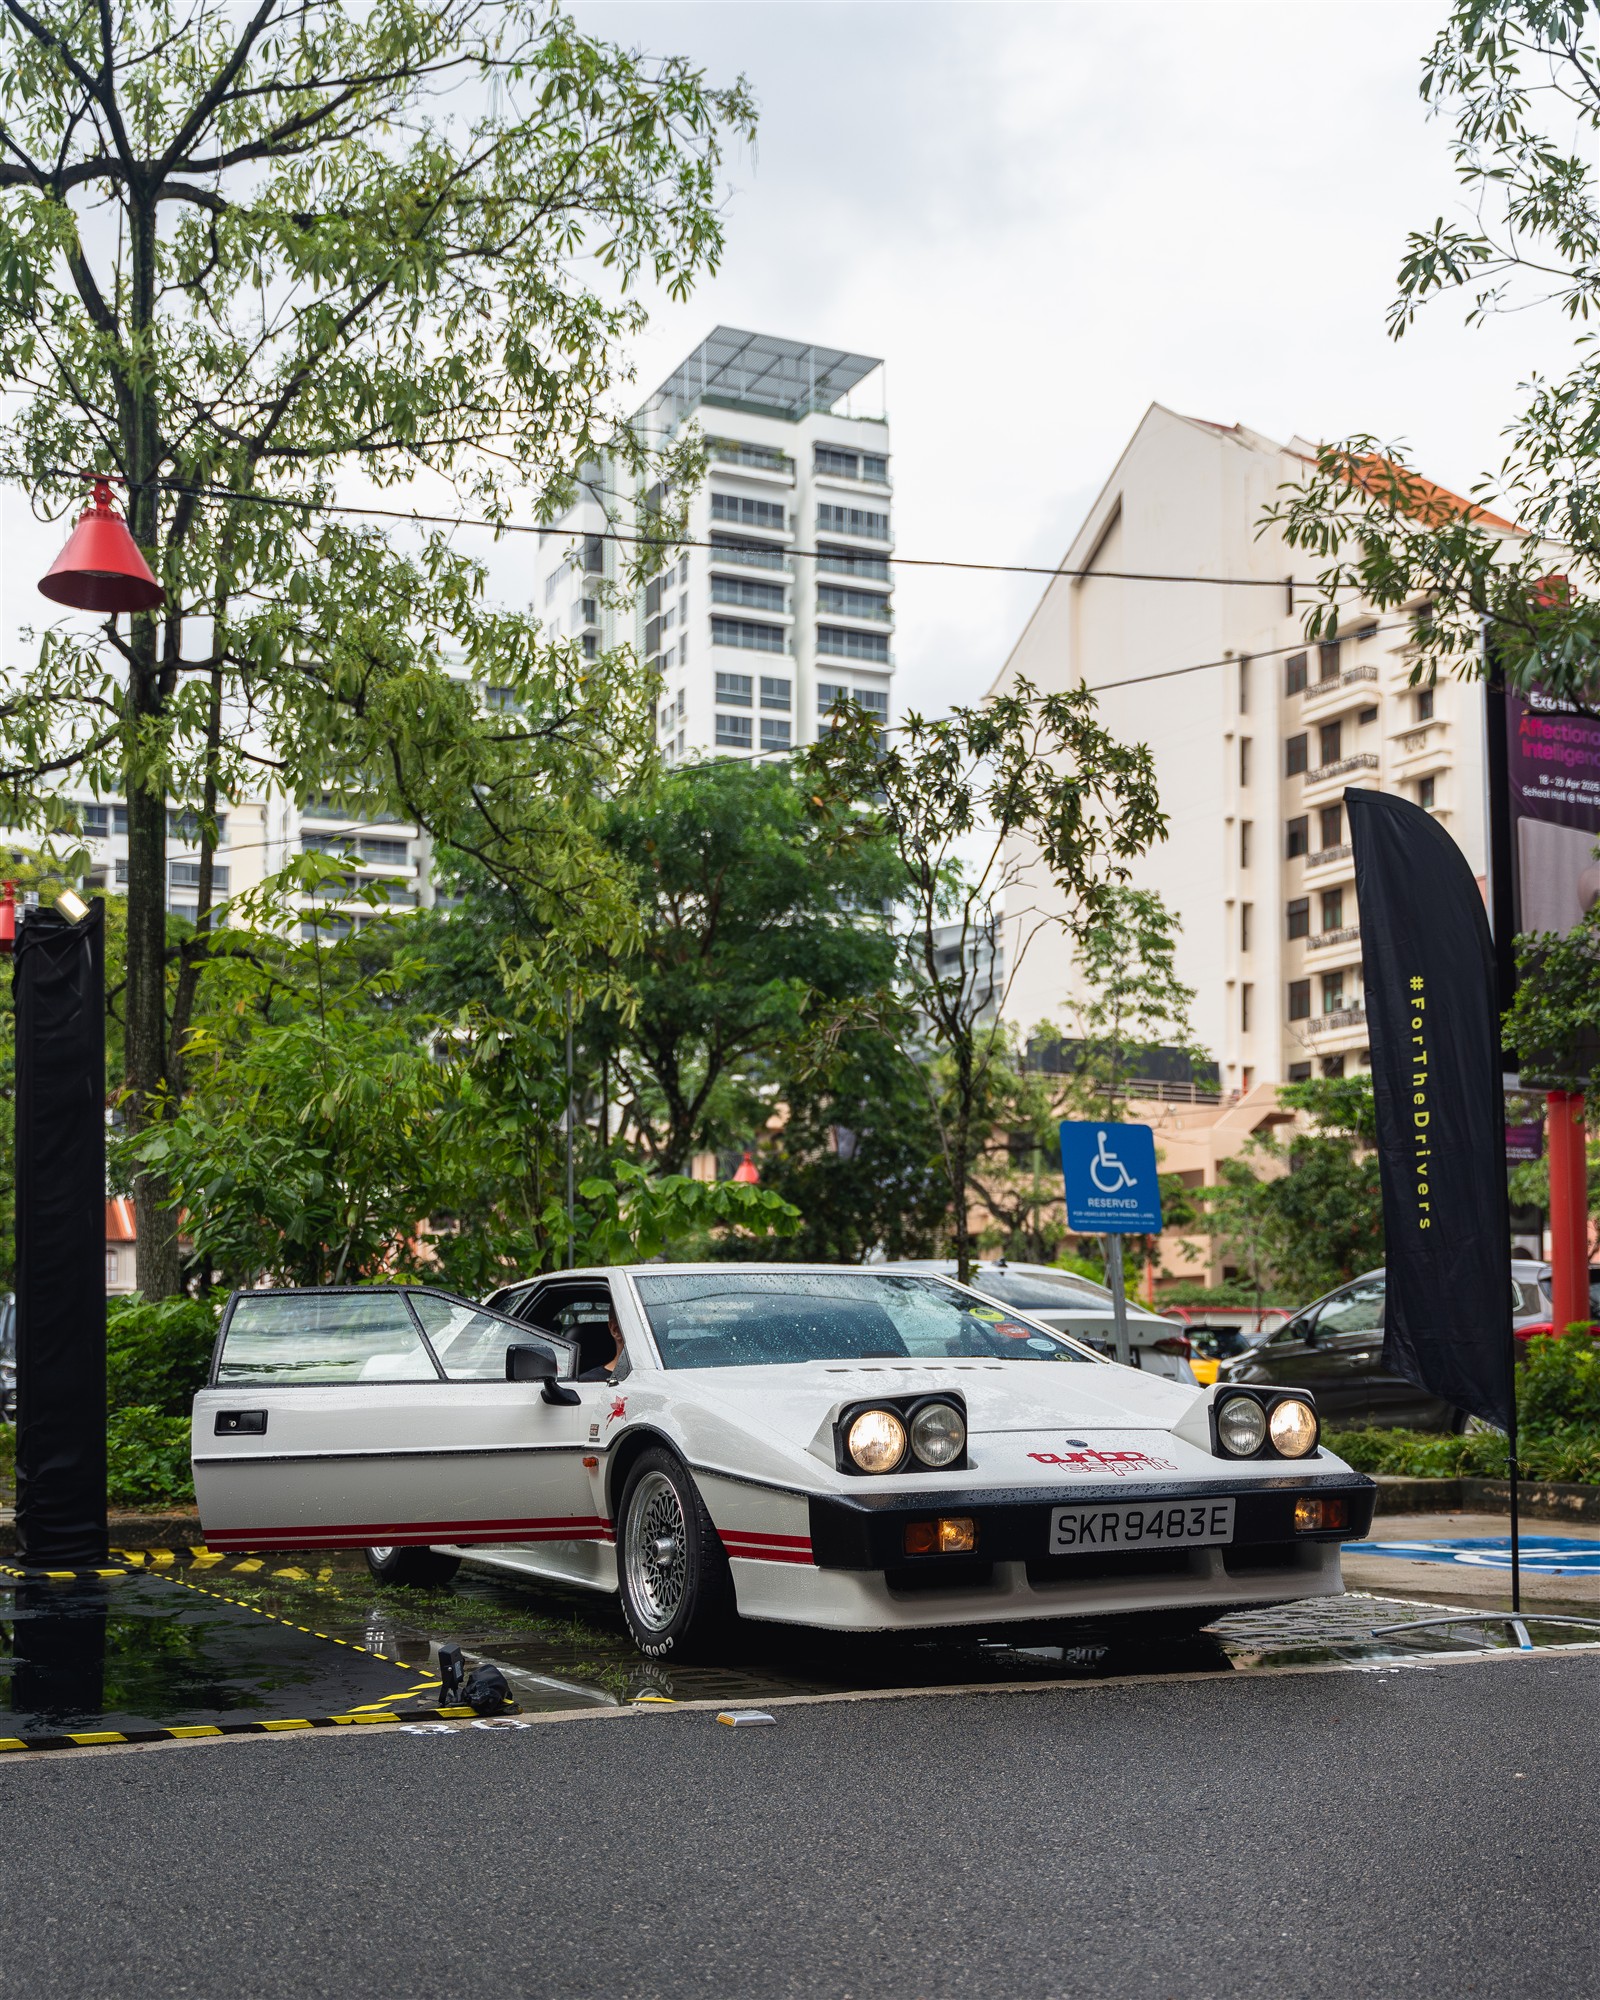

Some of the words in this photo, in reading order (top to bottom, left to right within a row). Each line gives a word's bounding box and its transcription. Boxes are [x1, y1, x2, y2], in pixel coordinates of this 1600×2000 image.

[1409, 976, 1431, 1230] #ForTheDrivers
[1087, 1197, 1138, 1209] RESERVED
[1026, 1449, 1148, 1463] turbo
[1058, 1456, 1178, 1477] esprit
[1057, 1505, 1229, 1546] SKR9483E
